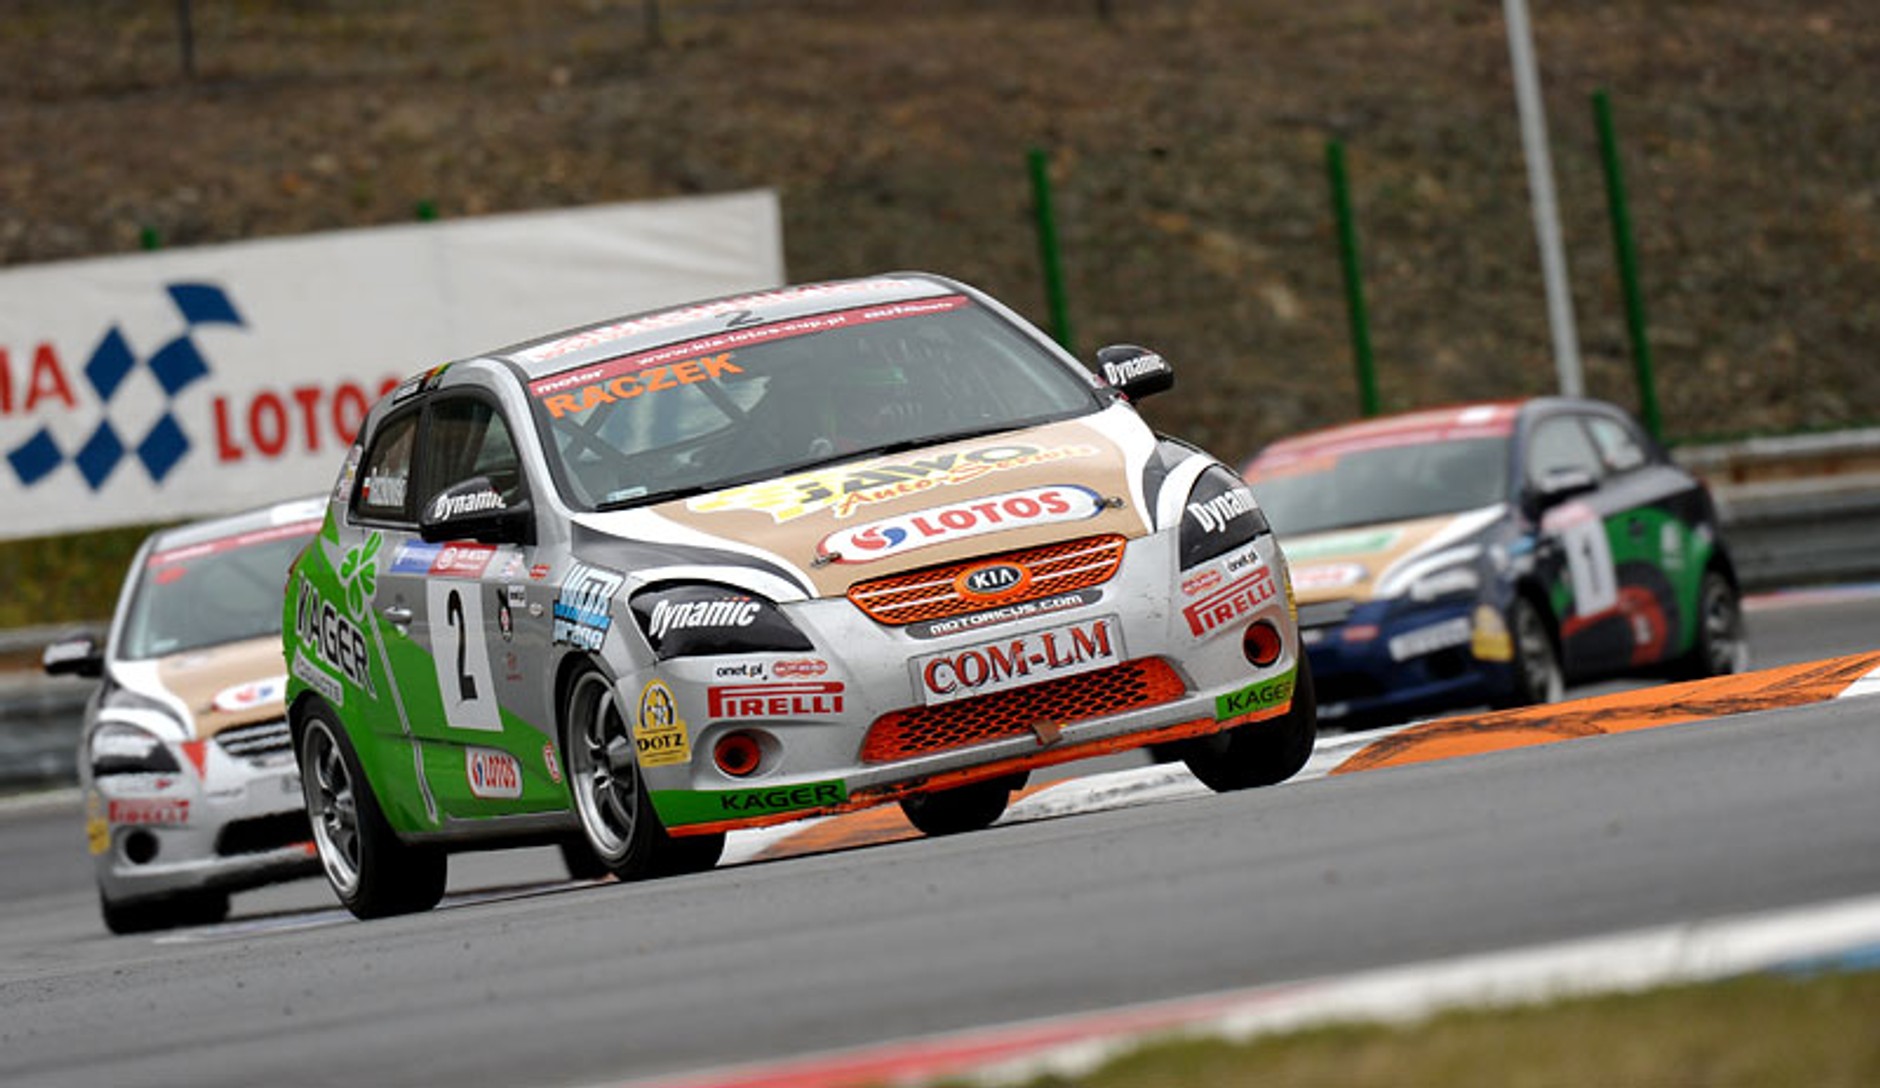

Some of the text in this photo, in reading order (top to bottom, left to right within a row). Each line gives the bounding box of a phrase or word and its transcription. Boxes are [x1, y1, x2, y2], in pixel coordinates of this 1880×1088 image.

[714, 310, 762, 328] 2
[537, 369, 604, 393] motor
[543, 352, 744, 420] RACZEK
[911, 491, 1071, 537] LOTOS
[973, 569, 1015, 589] KIA
[649, 600, 760, 639] Dynamic
[1183, 565, 1276, 638] PIRELLI
[447, 589, 478, 700] 2
[924, 620, 1113, 695] COM-LM
[716, 663, 764, 678] onet.pl
[707, 681, 845, 718] PIRELLI
[636, 733, 685, 751] DOTZ
[482, 753, 516, 788] LOTOS
